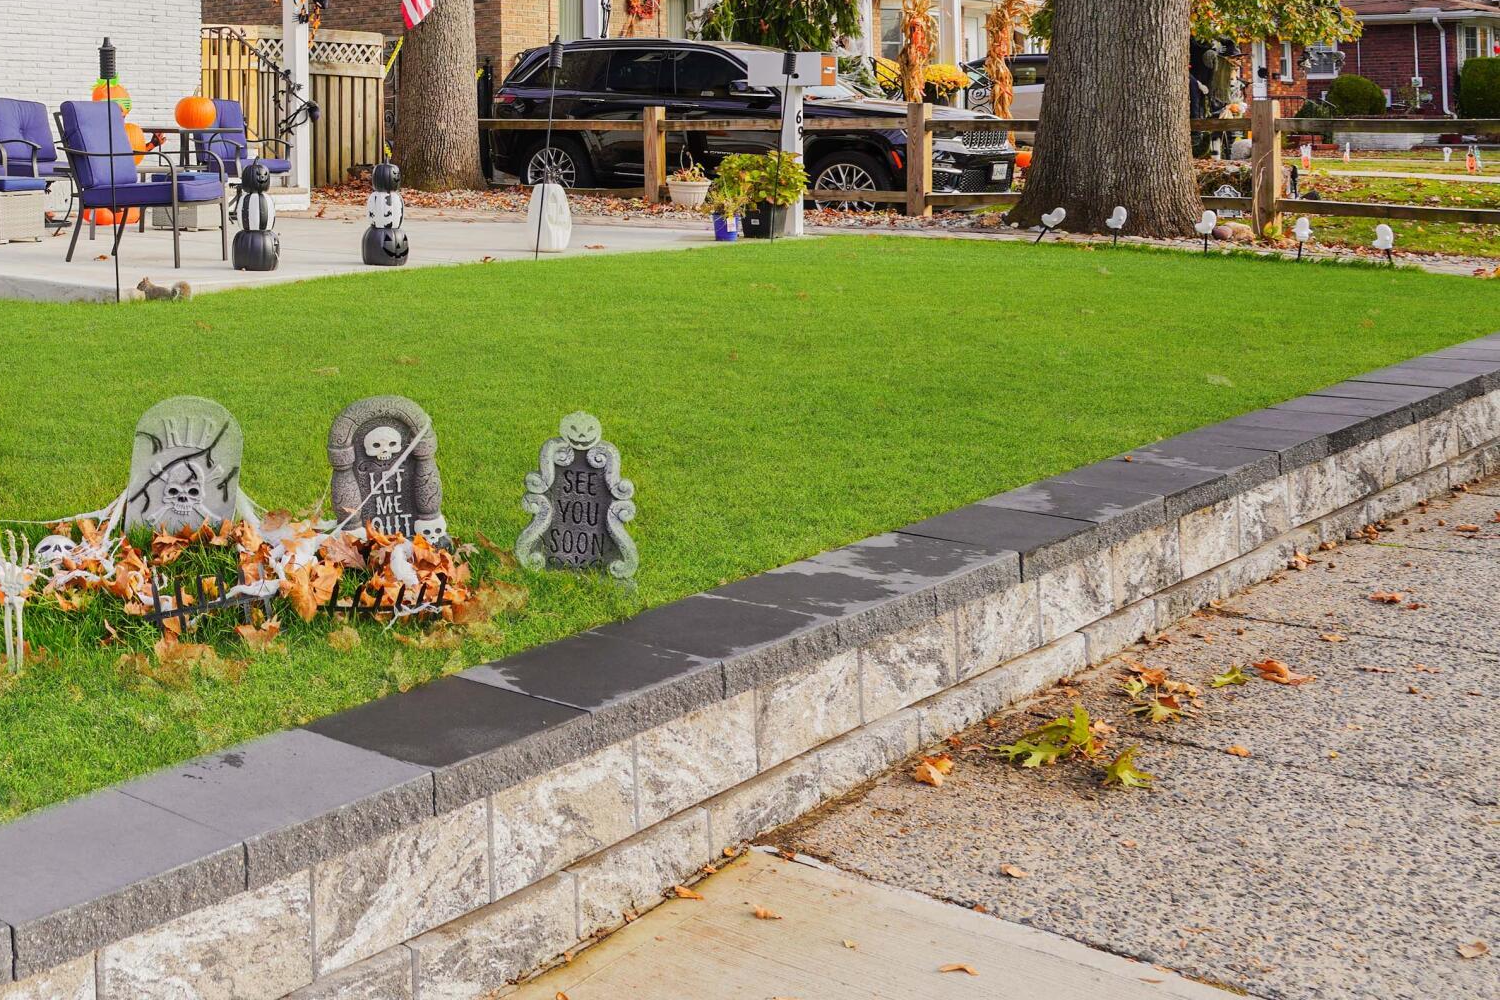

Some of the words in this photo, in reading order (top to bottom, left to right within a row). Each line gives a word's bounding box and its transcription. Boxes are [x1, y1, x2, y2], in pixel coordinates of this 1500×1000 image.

[369, 468, 405, 495] LET
[563, 469, 598, 496] SEE
[376, 494, 403, 515] ME
[558, 500, 599, 526] YOU
[371, 513, 412, 538] OUT
[550, 528, 605, 557] SOON
